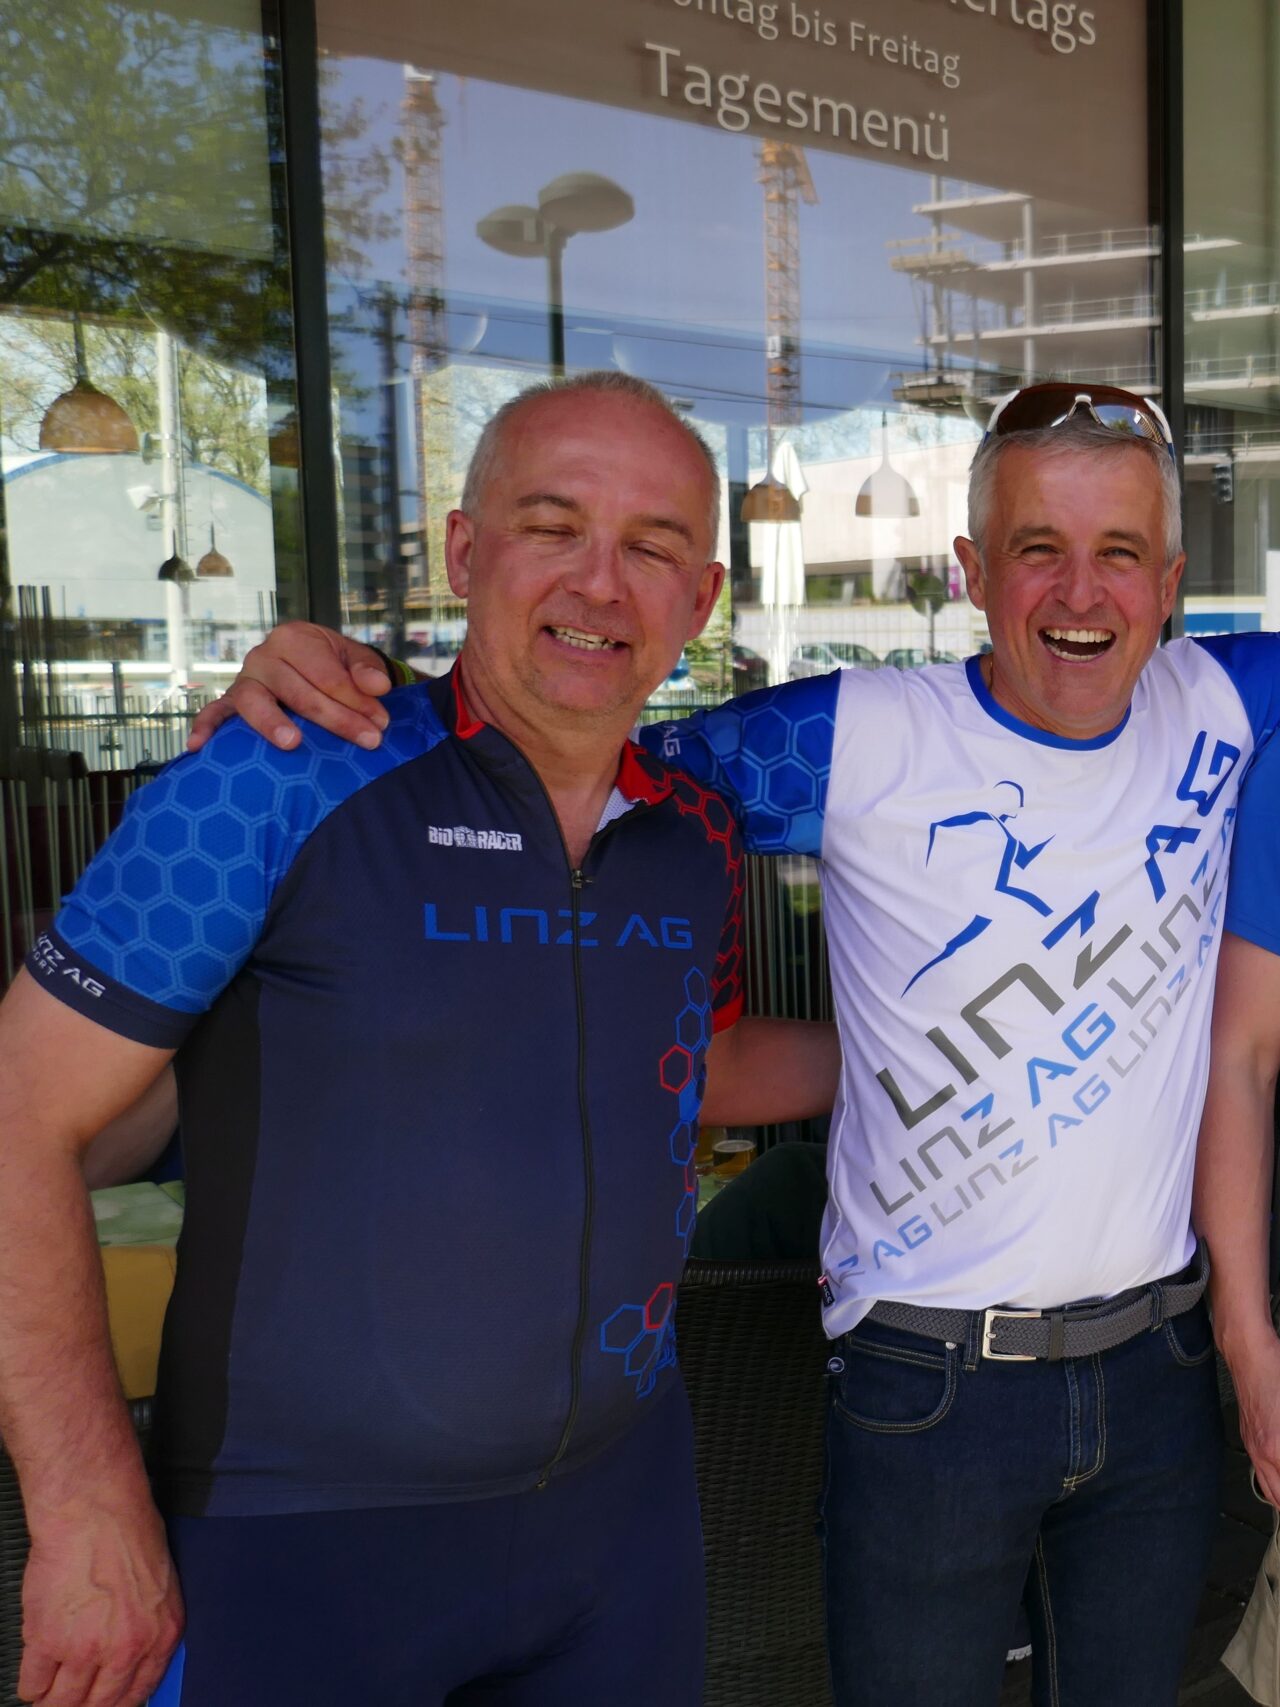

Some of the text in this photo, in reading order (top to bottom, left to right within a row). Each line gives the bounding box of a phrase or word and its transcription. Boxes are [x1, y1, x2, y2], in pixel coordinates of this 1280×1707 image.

[645, 42, 950, 162] Tagesmenü
[791, 2, 837, 47] bis
[850, 21, 961, 89] Freitag
[63, 967, 106, 998] AG
[424, 902, 694, 949] LINZ AG
[875, 890, 1133, 1131] LINZ
[869, 1092, 1016, 1216] LINZ
[1027, 1002, 1116, 1108] AG
[873, 1215, 933, 1270] AG
[1048, 1073, 1112, 1149] AG
